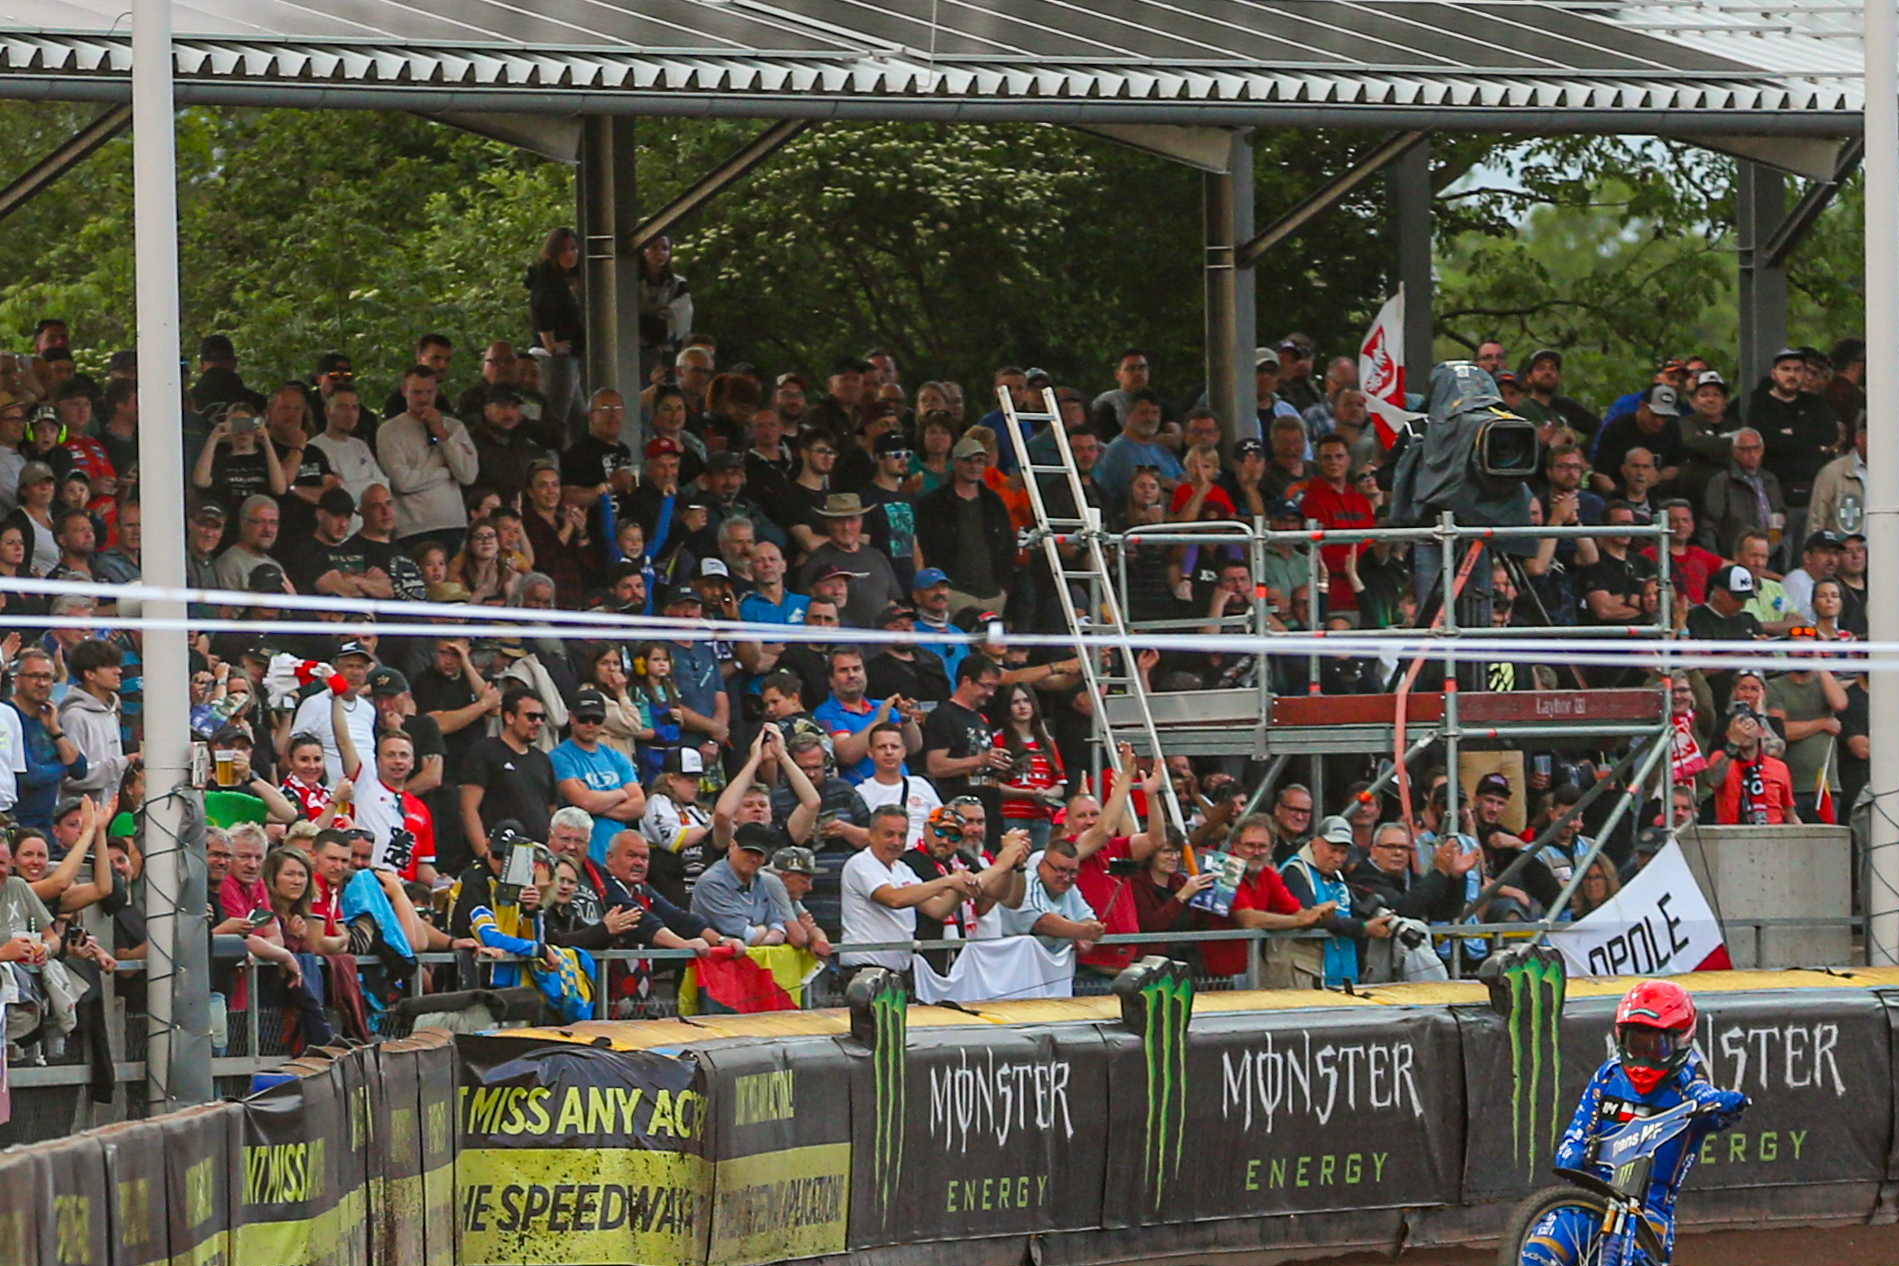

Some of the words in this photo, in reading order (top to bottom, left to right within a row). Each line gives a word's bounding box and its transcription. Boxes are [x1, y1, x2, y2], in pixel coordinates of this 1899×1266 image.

[1589, 891, 1690, 976] OPOLE
[1222, 1031, 1424, 1133] MONSTER
[1606, 1012, 1846, 1096] NSTER
[468, 1086, 552, 1136] MISS
[555, 1086, 643, 1135] ANY
[930, 1046, 1074, 1154] MONSTER
[1245, 1153, 1388, 1191] ENERGY
[1700, 1130, 1808, 1164] ERGY
[947, 1175, 1048, 1212] ENERGY
